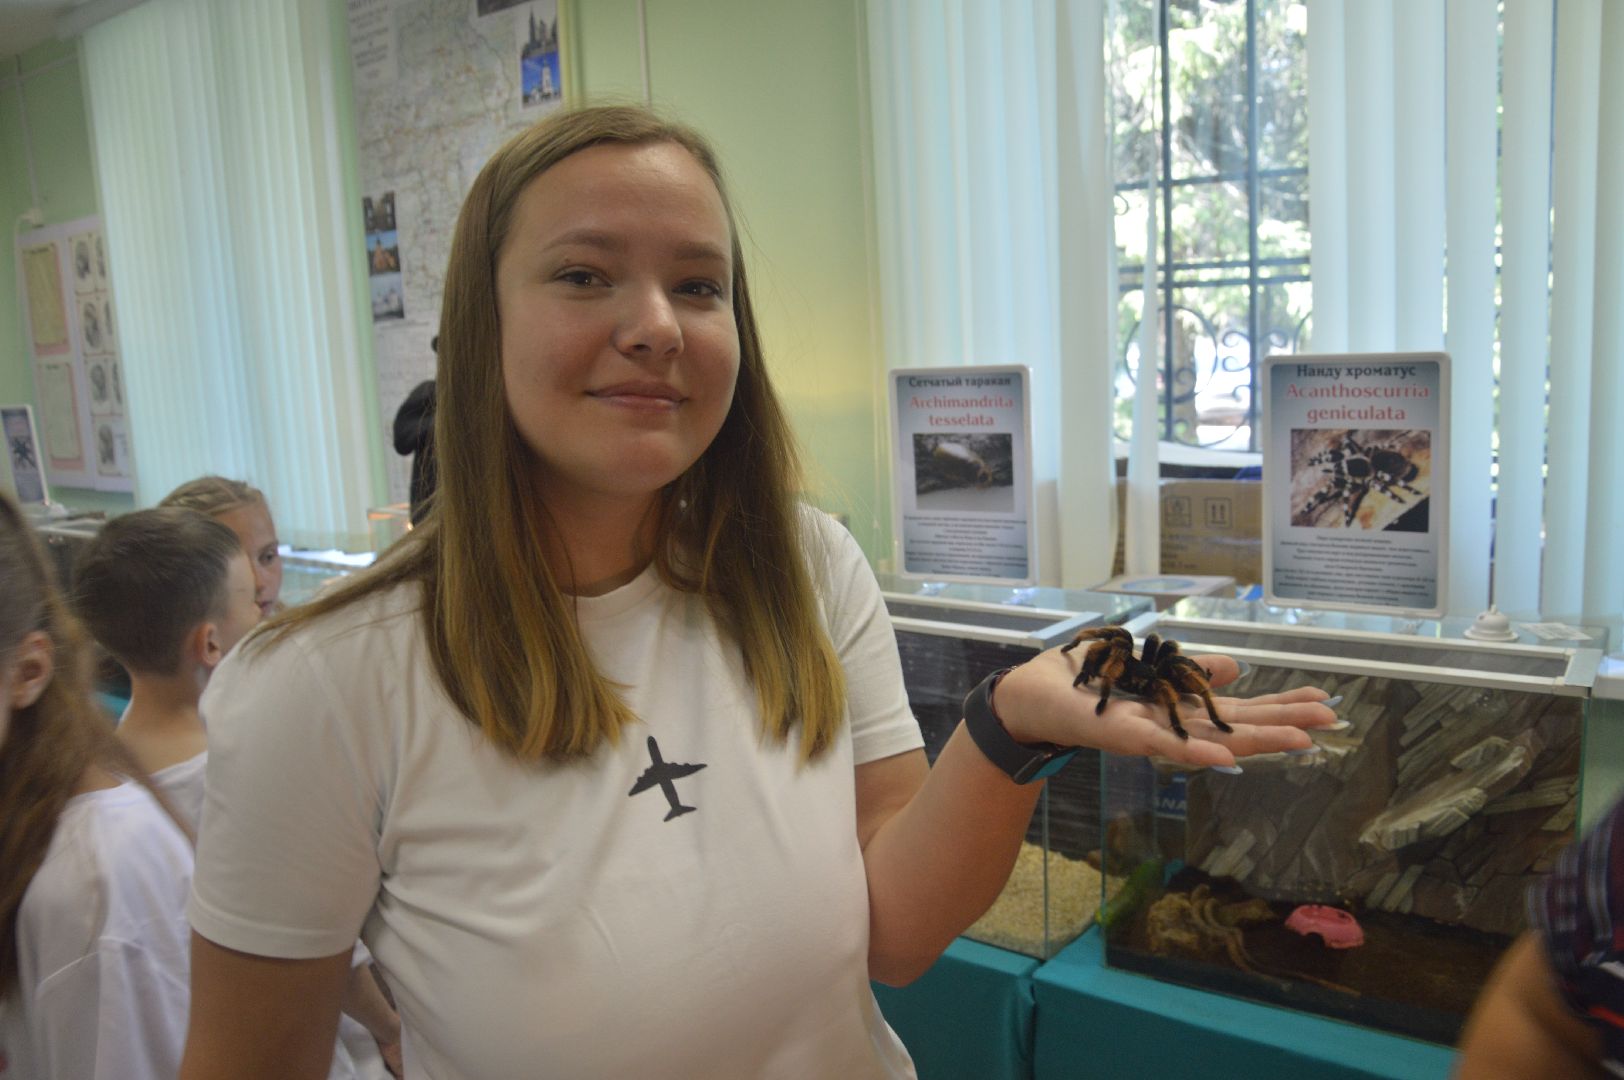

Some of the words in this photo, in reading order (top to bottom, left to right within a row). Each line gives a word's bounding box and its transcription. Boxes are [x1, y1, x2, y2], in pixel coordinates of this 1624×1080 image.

[1296, 364, 1342, 380] Нанду
[1345, 365, 1417, 380] хроматус
[908, 376, 963, 389] Сетчатый
[964, 378, 1012, 389] таракан
[1286, 383, 1430, 399] Acanthoscurria
[910, 395, 1014, 410] Archimandrita
[928, 413, 995, 427] tesselata
[1306, 404, 1406, 424] geniculata
